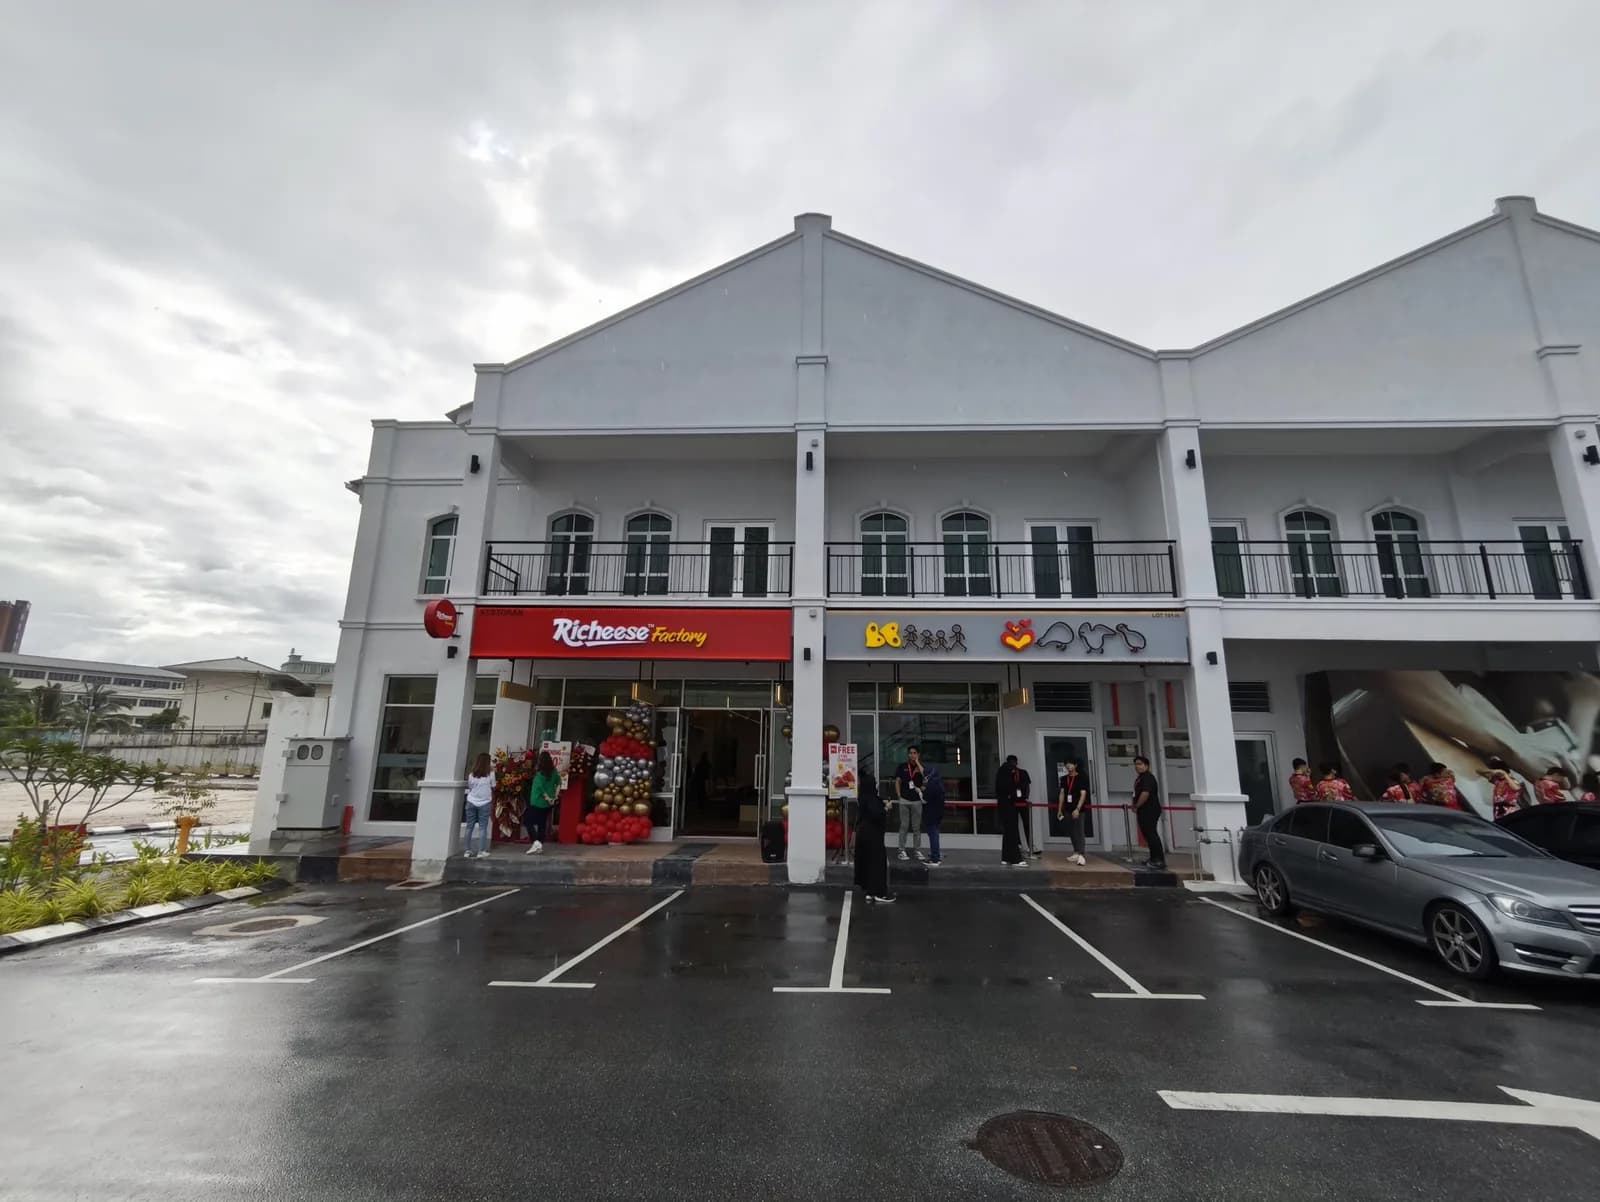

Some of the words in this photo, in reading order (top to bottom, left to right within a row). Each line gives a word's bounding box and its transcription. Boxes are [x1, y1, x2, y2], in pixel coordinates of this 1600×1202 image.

[553, 618, 649, 647] Richeese
[651, 626, 707, 648] Factory
[838, 746, 855, 754] FREE
